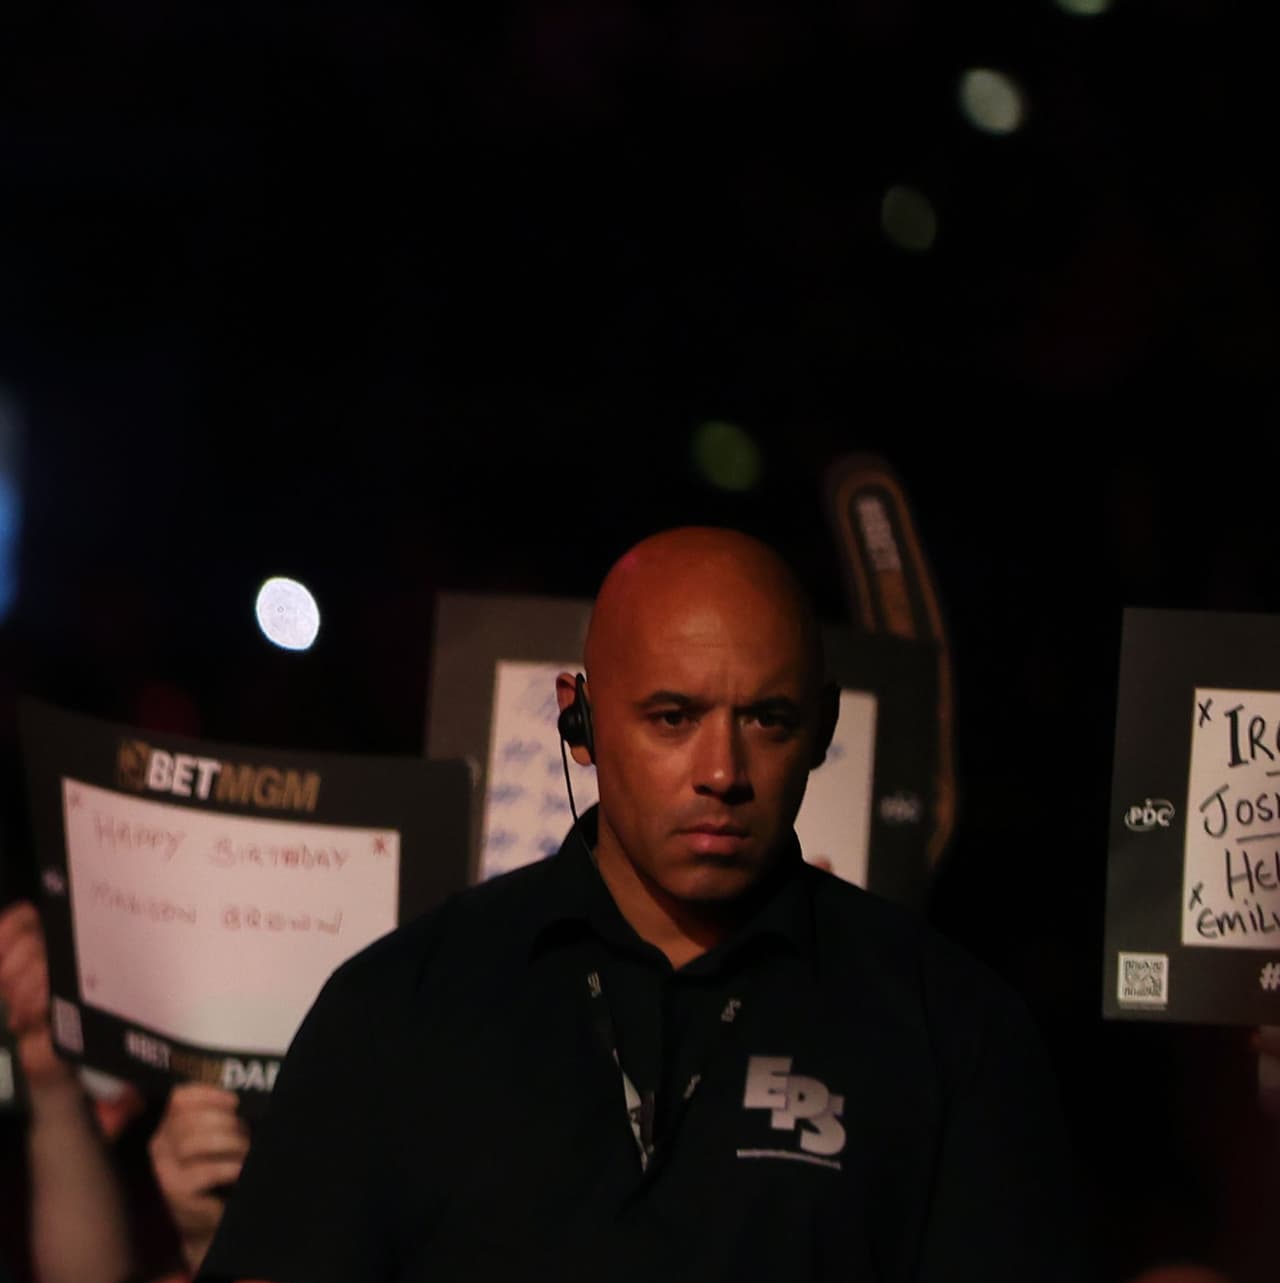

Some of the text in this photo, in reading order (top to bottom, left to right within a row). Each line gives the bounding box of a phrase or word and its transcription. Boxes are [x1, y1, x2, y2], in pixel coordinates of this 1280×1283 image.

[145, 748, 322, 813] BETMGM
[1200, 784, 1280, 838] JOS
[743, 1055, 847, 1156] EPS
